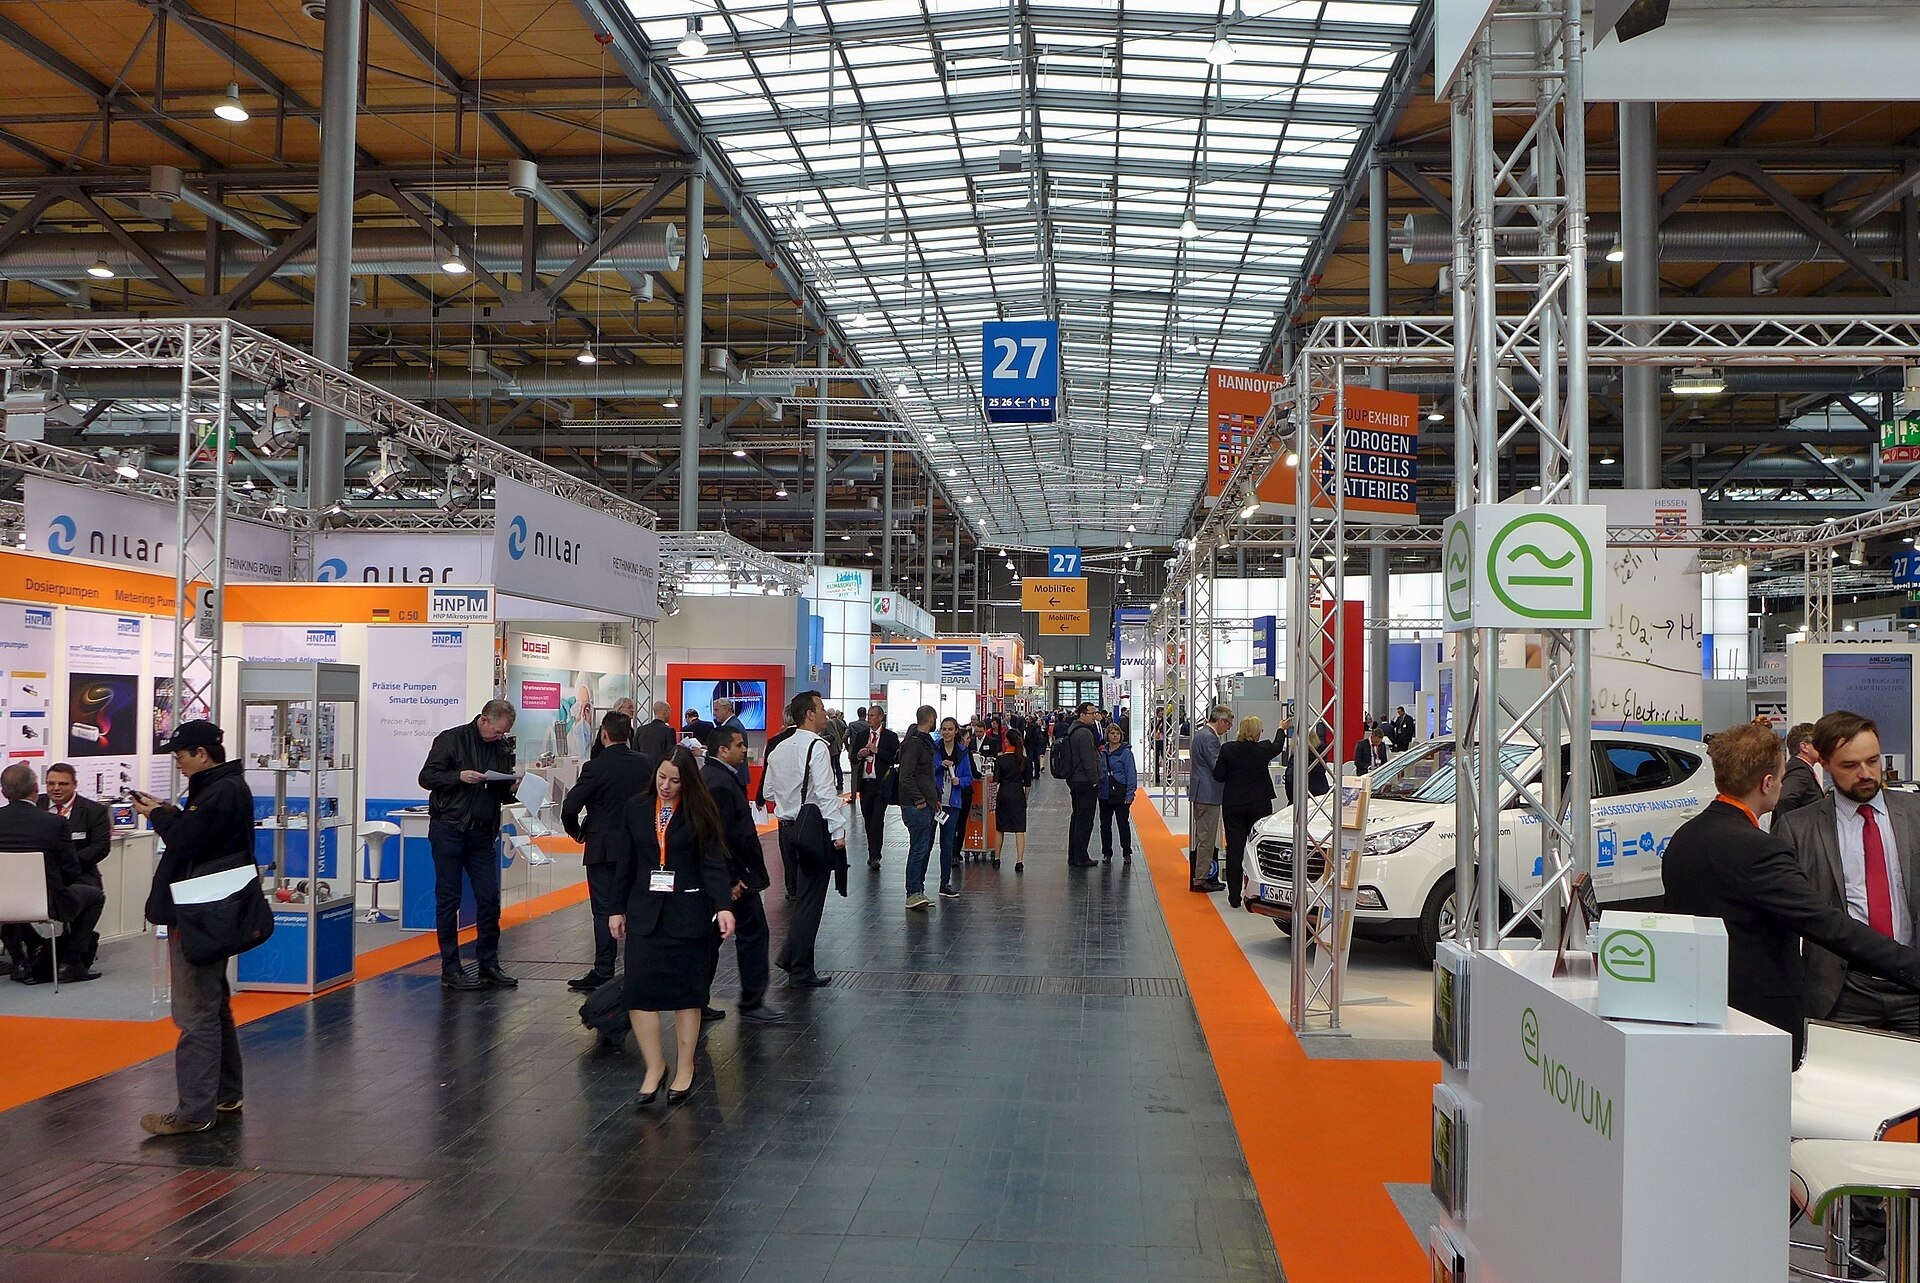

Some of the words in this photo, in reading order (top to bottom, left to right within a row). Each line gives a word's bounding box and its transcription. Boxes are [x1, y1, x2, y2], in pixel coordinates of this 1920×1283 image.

[993, 337, 1047, 379] 27
[989, 398, 1000, 407] 25
[1001, 398, 1013, 407] 26
[1040, 398, 1050, 407] 13
[1331, 405, 1410, 427] OUPEXHIBIT
[1368, 455, 1410, 478] CELLS
[1654, 499, 1688, 507] HESSEN
[90, 531, 163, 563] nilar
[534, 531, 581, 565] nilar
[259, 562, 283, 577] POWER
[612, 556, 639, 575] RETHINKING
[638, 564, 654, 579] POWER
[1053, 554, 1077, 573] 27
[1894, 557, 1908, 578] 27
[1914, 556, 1920, 576] 2
[25, 577, 99, 598] Dosierpumpen
[114, 589, 155, 608] Metering
[156, 595, 176, 608] Pum
[1034, 585, 1076, 593] MobiliTec
[204, 610, 213, 618] 50
[398, 611, 405, 621] C
[407, 610, 419, 621] 50
[446, 613, 488, 621] Mikrosysteme
[521, 637, 550, 654] bosal
[879, 662, 899, 672] IWI
[372, 681, 401, 691] Präzise
[403, 682, 437, 692] Pumpen
[941, 676, 971, 684] EBARA
[1757, 675, 1769, 685] EAS
[1770, 675, 1787, 685] Germa
[388, 695, 418, 705] Smarte
[419, 695, 459, 706] Lösungen
[1623, 688, 1698, 722] Electricit
[403, 718, 427, 726] Pumps
[393, 729, 413, 737] Smart
[413, 729, 441, 737] Solution
[1594, 796, 1699, 817] WASSERSTOFF-TANKSYSTEME
[1264, 886, 1275, 899] KS
[1278, 888, 1285, 900] R
[1543, 1054, 1612, 1141] NOVUM
